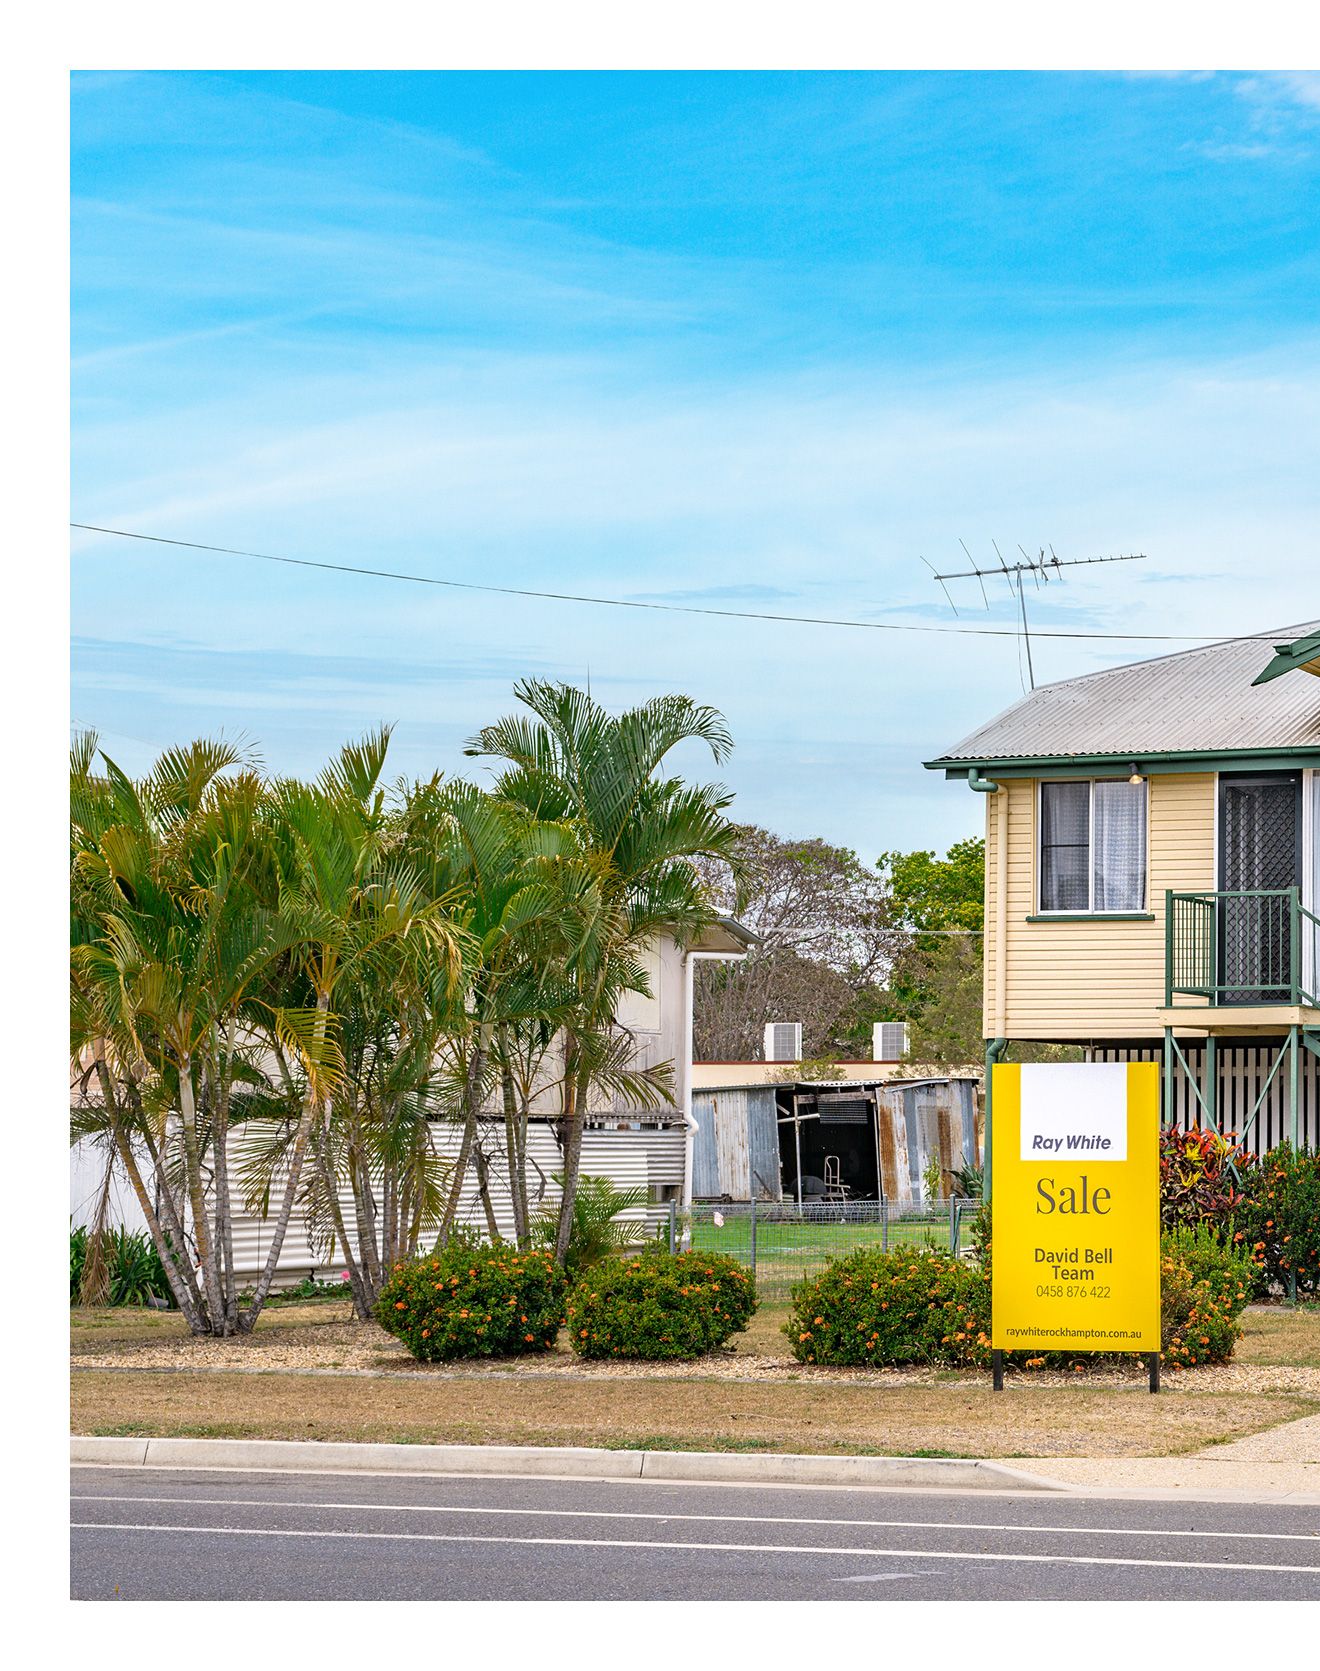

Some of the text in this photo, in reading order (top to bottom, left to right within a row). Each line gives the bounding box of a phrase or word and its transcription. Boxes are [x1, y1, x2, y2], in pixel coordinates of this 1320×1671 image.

[1032, 1134, 1111, 1152] Ray White
[1036, 1176, 1111, 1215] Sale
[1034, 1248, 1113, 1264] David Bell
[1051, 1266, 1095, 1281] Team
[1036, 1286, 1111, 1298] 0458 876 422
[1006, 1327, 1142, 1339] raywhiterockhampton.com.au
